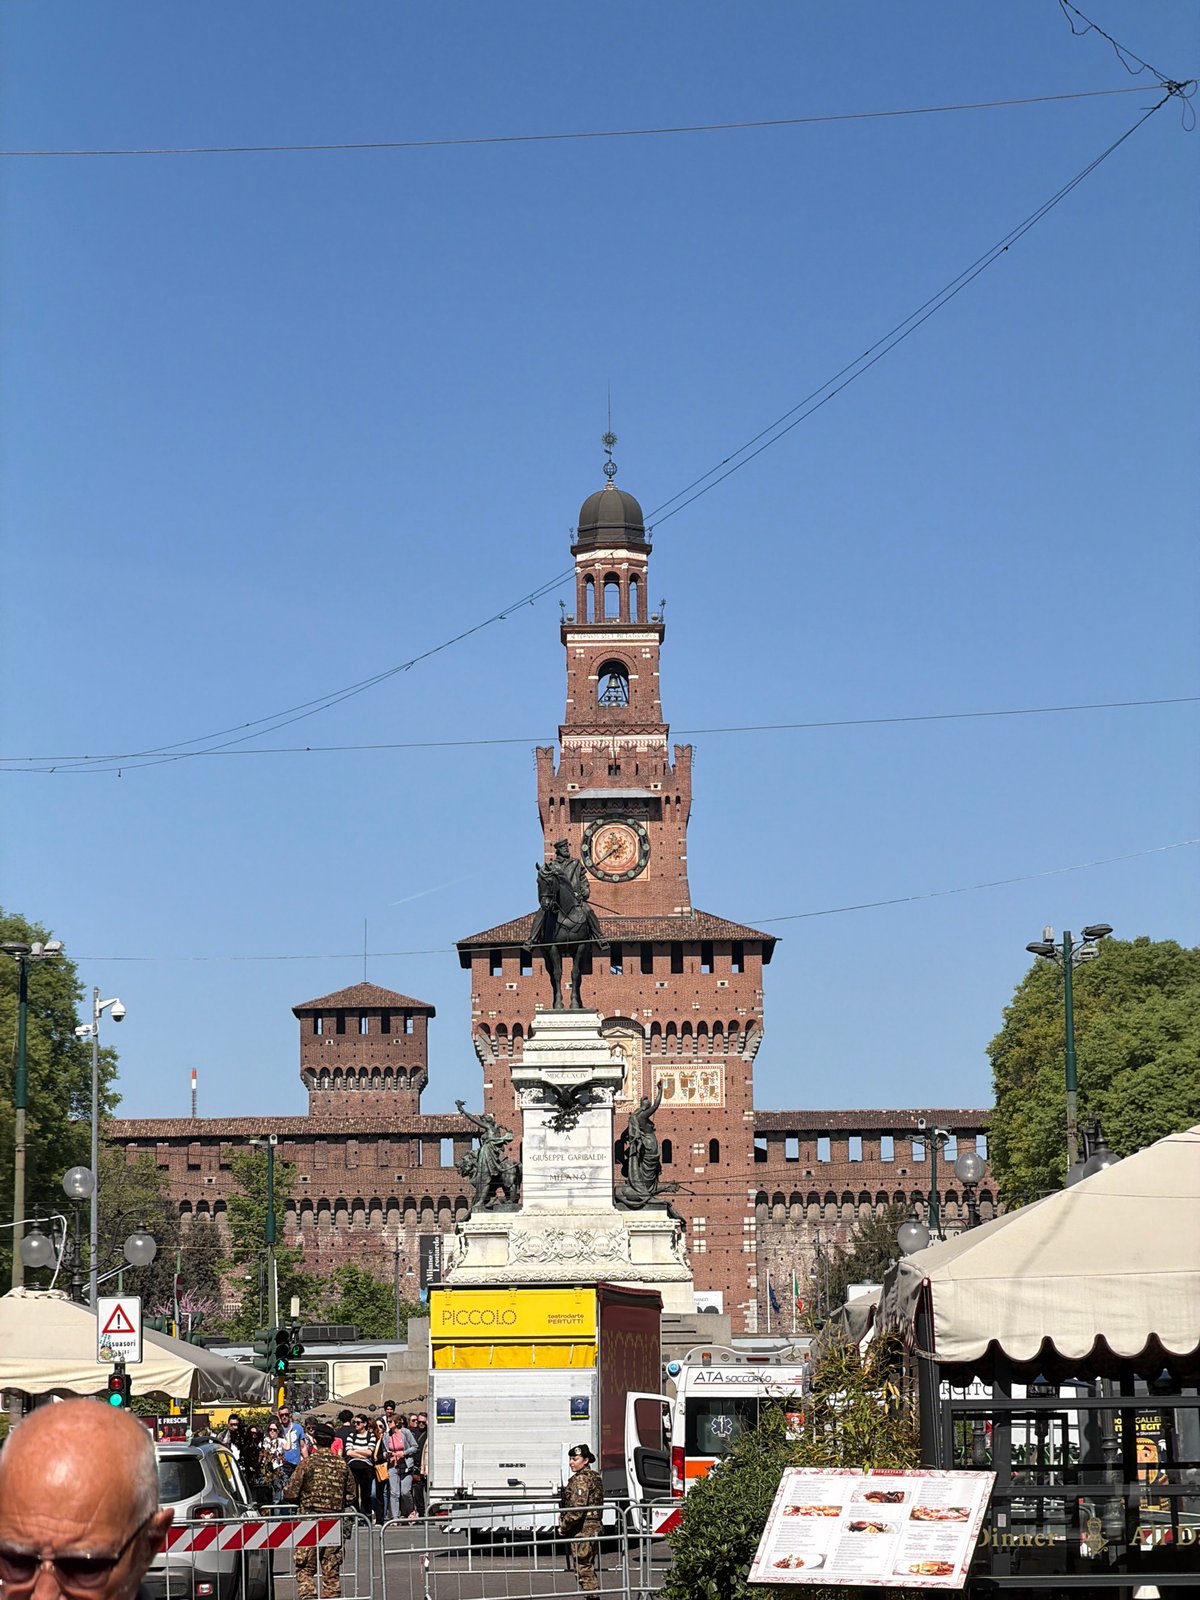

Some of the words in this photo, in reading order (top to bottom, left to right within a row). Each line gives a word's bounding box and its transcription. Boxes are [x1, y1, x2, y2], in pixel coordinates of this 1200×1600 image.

[432, 1236, 440, 1272] Leonardo
[426, 1256, 434, 1282] Milano
[442, 1309, 517, 1326] PICCOLO
[694, 1371, 724, 1383] ATA
